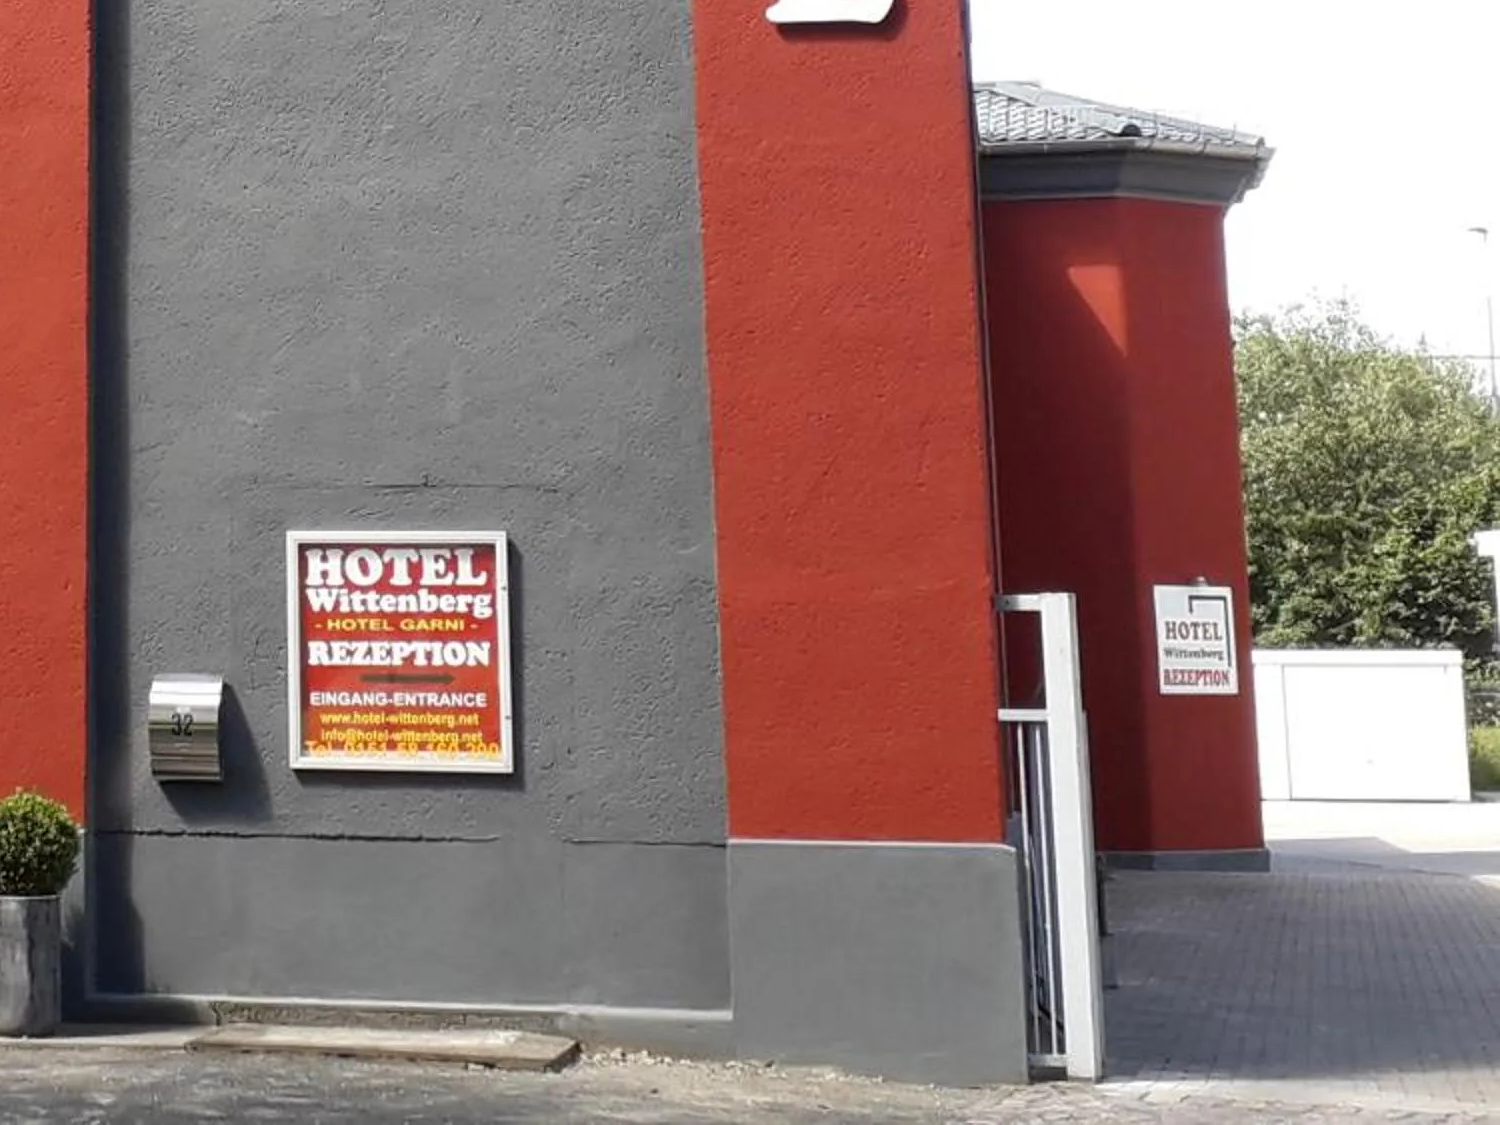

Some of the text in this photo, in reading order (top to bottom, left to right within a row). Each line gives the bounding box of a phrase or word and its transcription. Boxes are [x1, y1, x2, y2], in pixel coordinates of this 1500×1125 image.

[304, 548, 488, 586] HOTEL
[305, 588, 493, 618] Wittenberg
[327, 618, 395, 632] HOTEL
[399, 618, 465, 632] GARNI
[1164, 620, 1223, 641] HOTEL
[307, 641, 491, 667] REZEPTION
[1163, 668, 1230, 687] REZEPTION
[309, 691, 488, 708] EINGANG-ENTRANCE
[171, 713, 194, 736] 32
[320, 712, 480, 727] www.hotel-wittenberg.net
[321, 728, 483, 743] info@hotel-wittenberg.net
